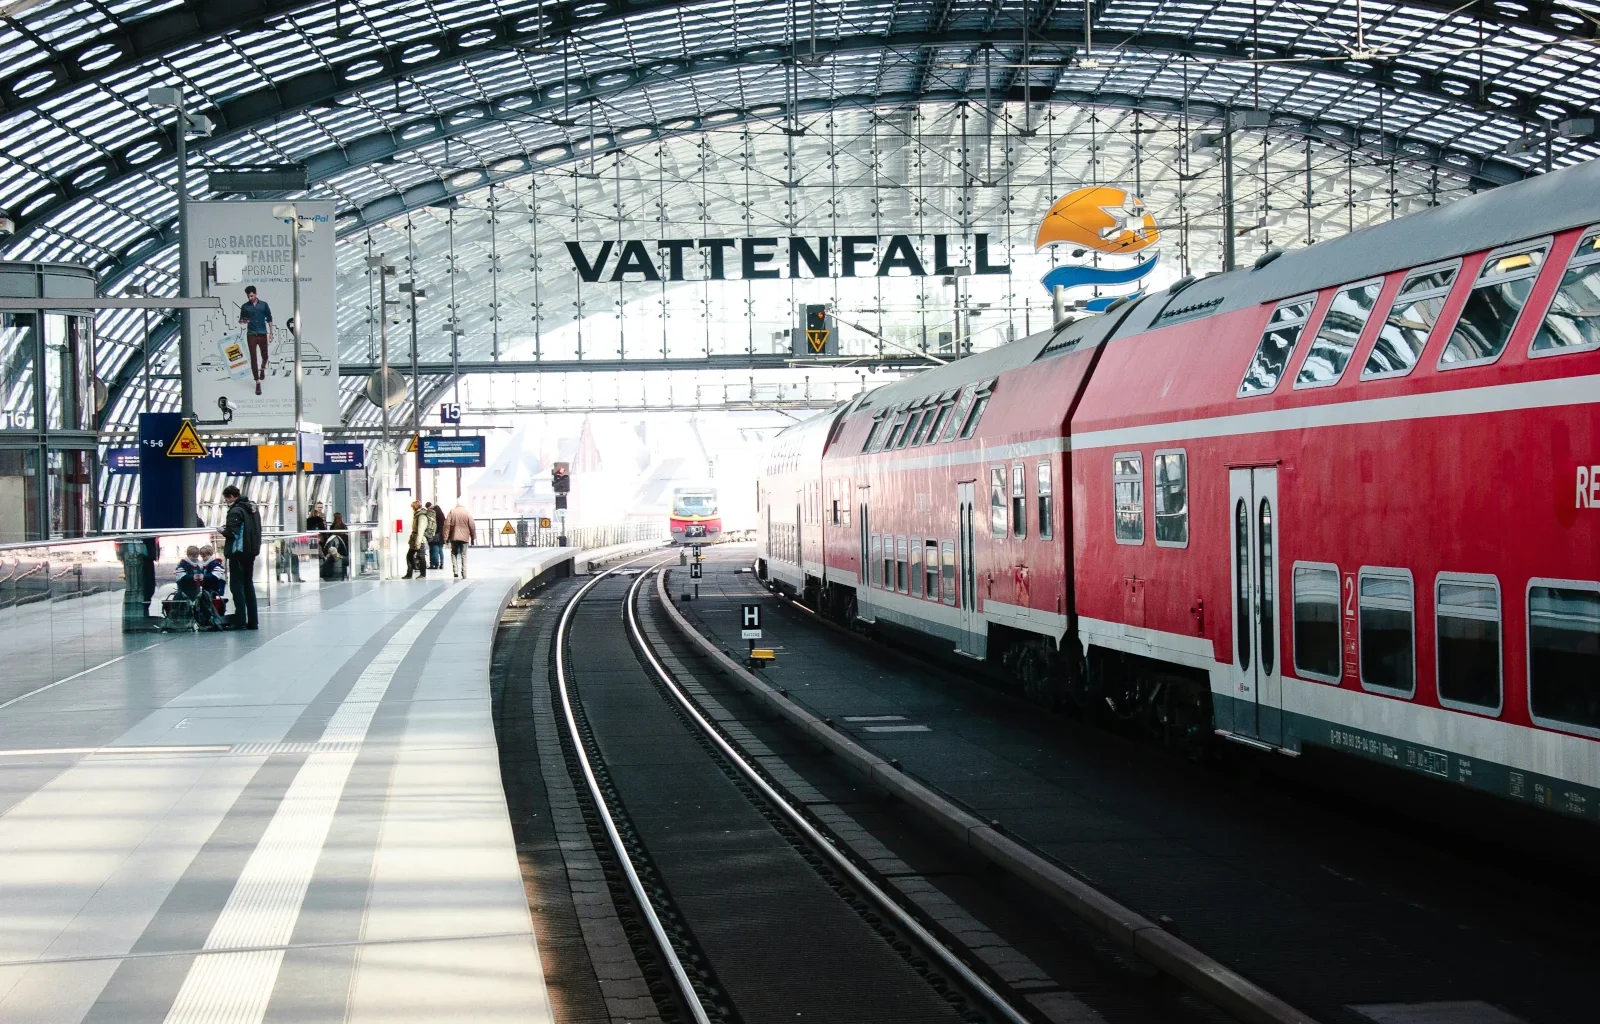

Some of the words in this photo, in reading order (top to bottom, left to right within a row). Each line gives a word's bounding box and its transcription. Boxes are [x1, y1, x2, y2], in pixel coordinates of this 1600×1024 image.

[208, 238, 227, 248] DAS
[229, 234, 313, 248] BARGELDLS-
[564, 233, 1010, 282] VATTENFALL
[7, 411, 26, 428] 16
[442, 403, 460, 419] 15
[1575, 465, 1600, 508] RE
[693, 546, 700, 555] H
[692, 564, 700, 576] H
[1345, 576, 1354, 616] 2
[744, 606, 758, 626] H
